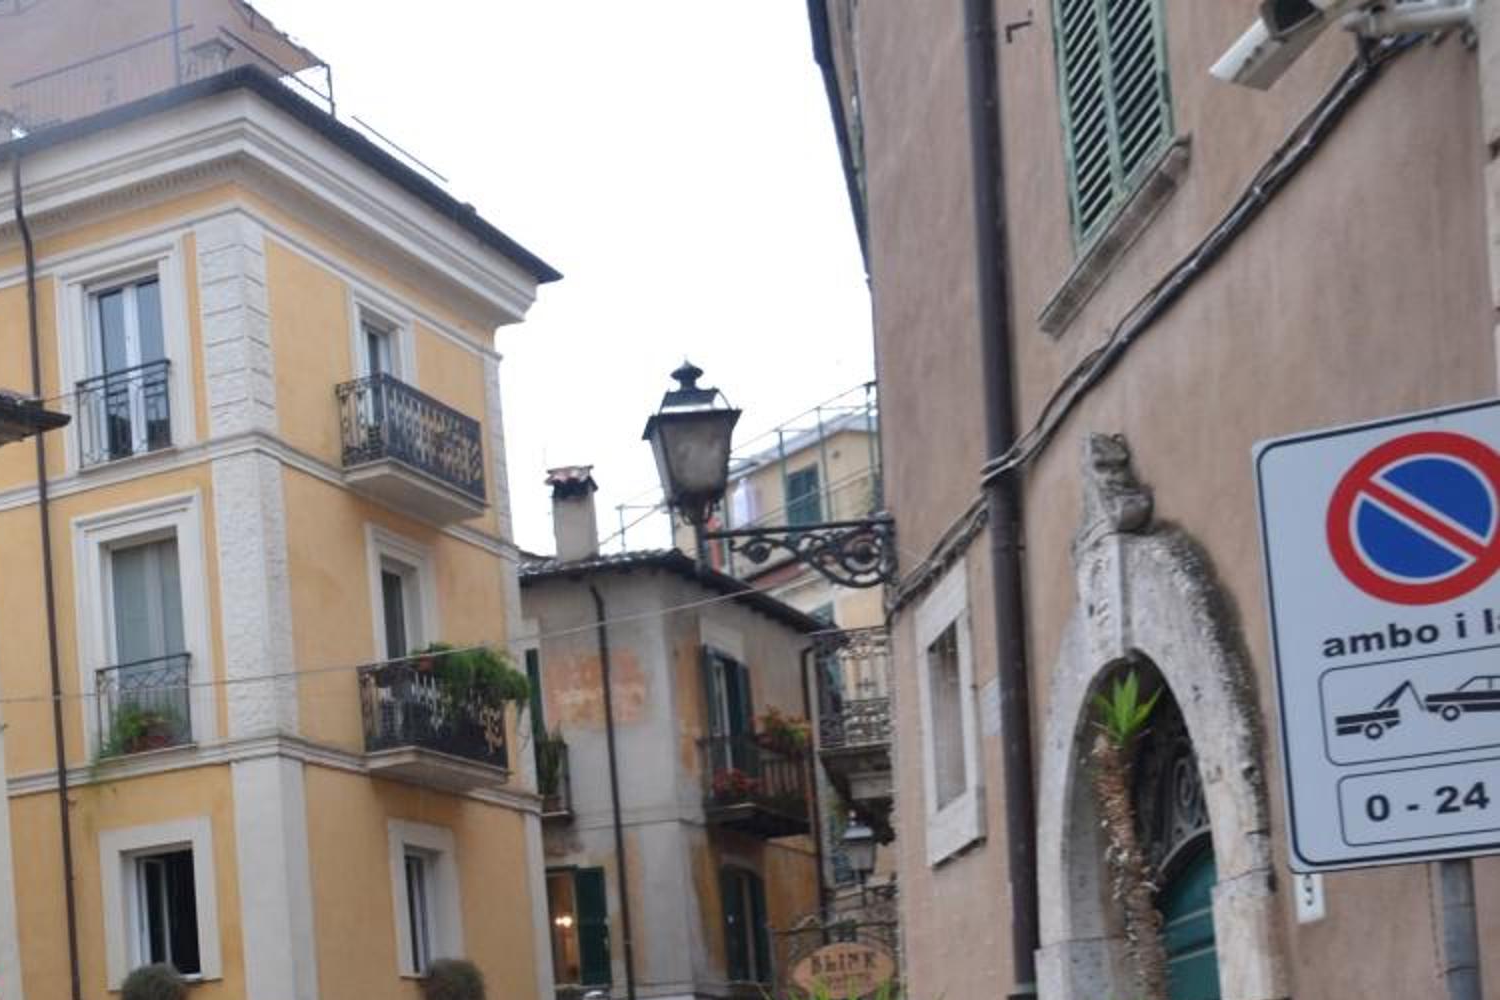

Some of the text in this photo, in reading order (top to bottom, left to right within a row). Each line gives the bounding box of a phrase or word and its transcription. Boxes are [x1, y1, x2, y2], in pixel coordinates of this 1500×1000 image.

[1322, 623, 1440, 658] ambo
[1455, 612, 1467, 639] i
[1365, 793, 1391, 823] 0
[1434, 781, 1490, 816] 24
